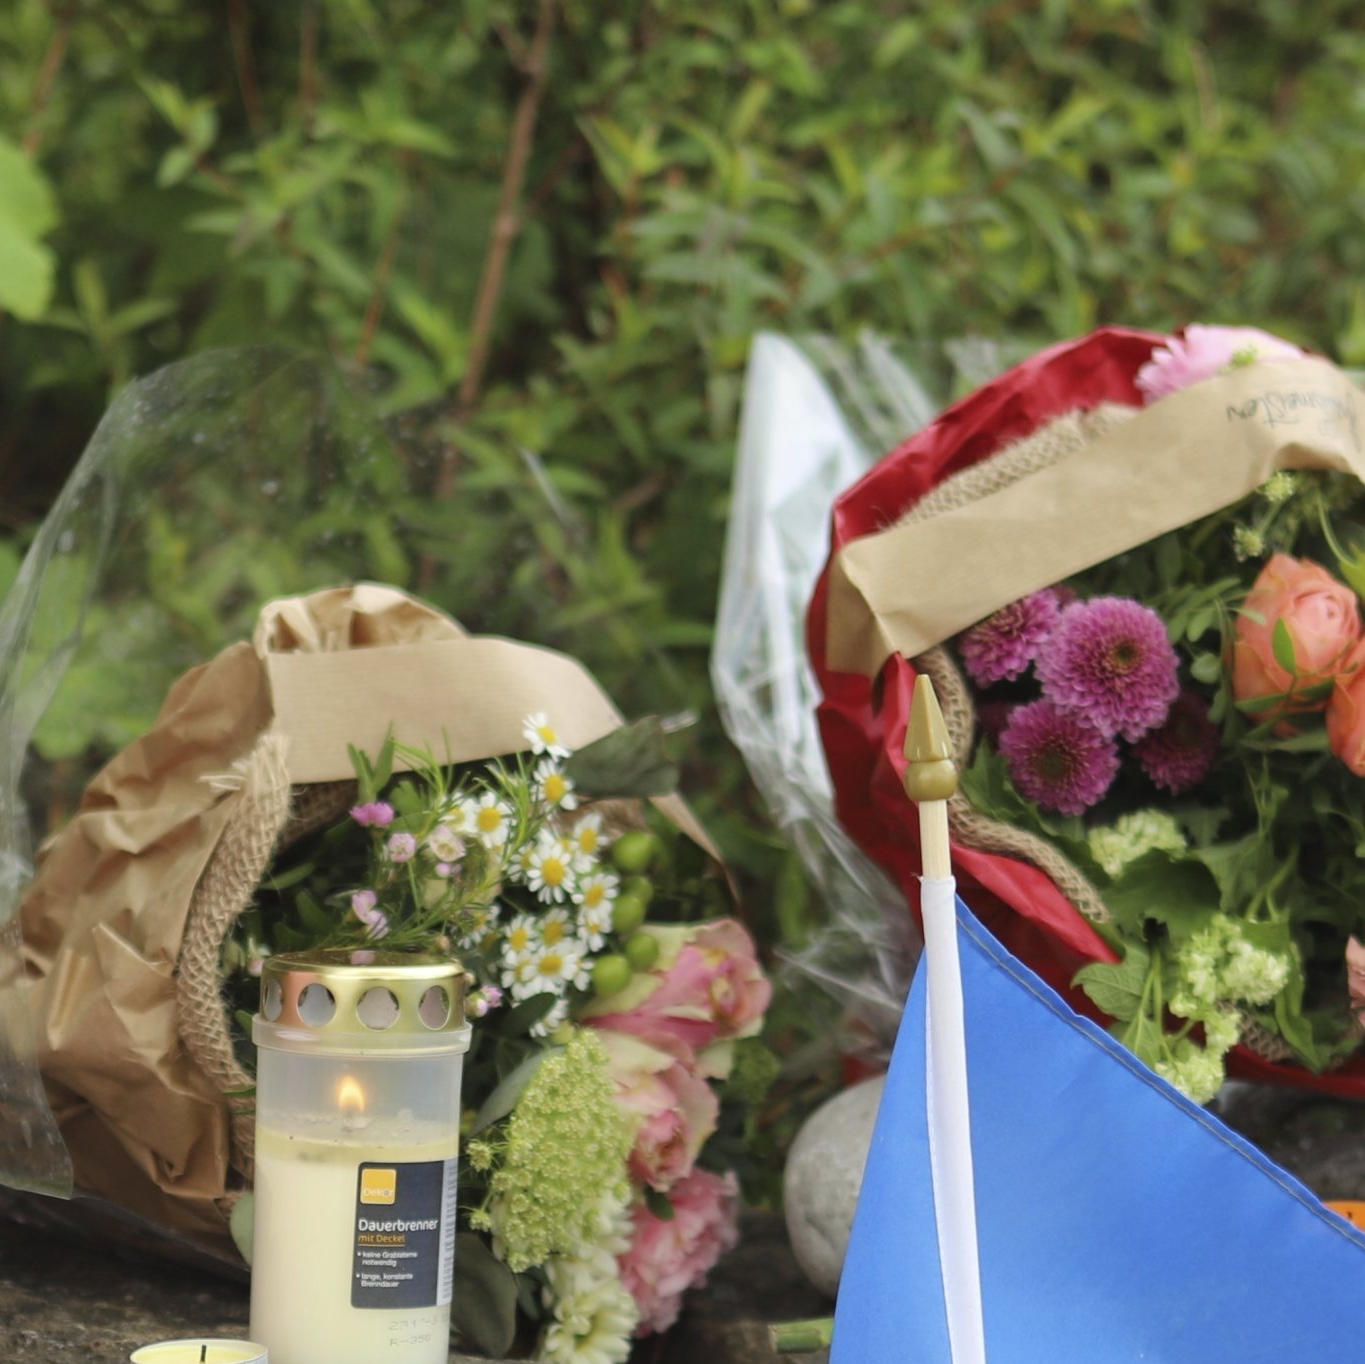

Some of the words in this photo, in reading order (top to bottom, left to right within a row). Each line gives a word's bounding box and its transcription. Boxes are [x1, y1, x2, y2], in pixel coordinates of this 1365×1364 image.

[358, 1219, 438, 1232] Dauerbrenner
[358, 1234, 375, 1243] mit
[376, 1234, 405, 1243] Deckel
